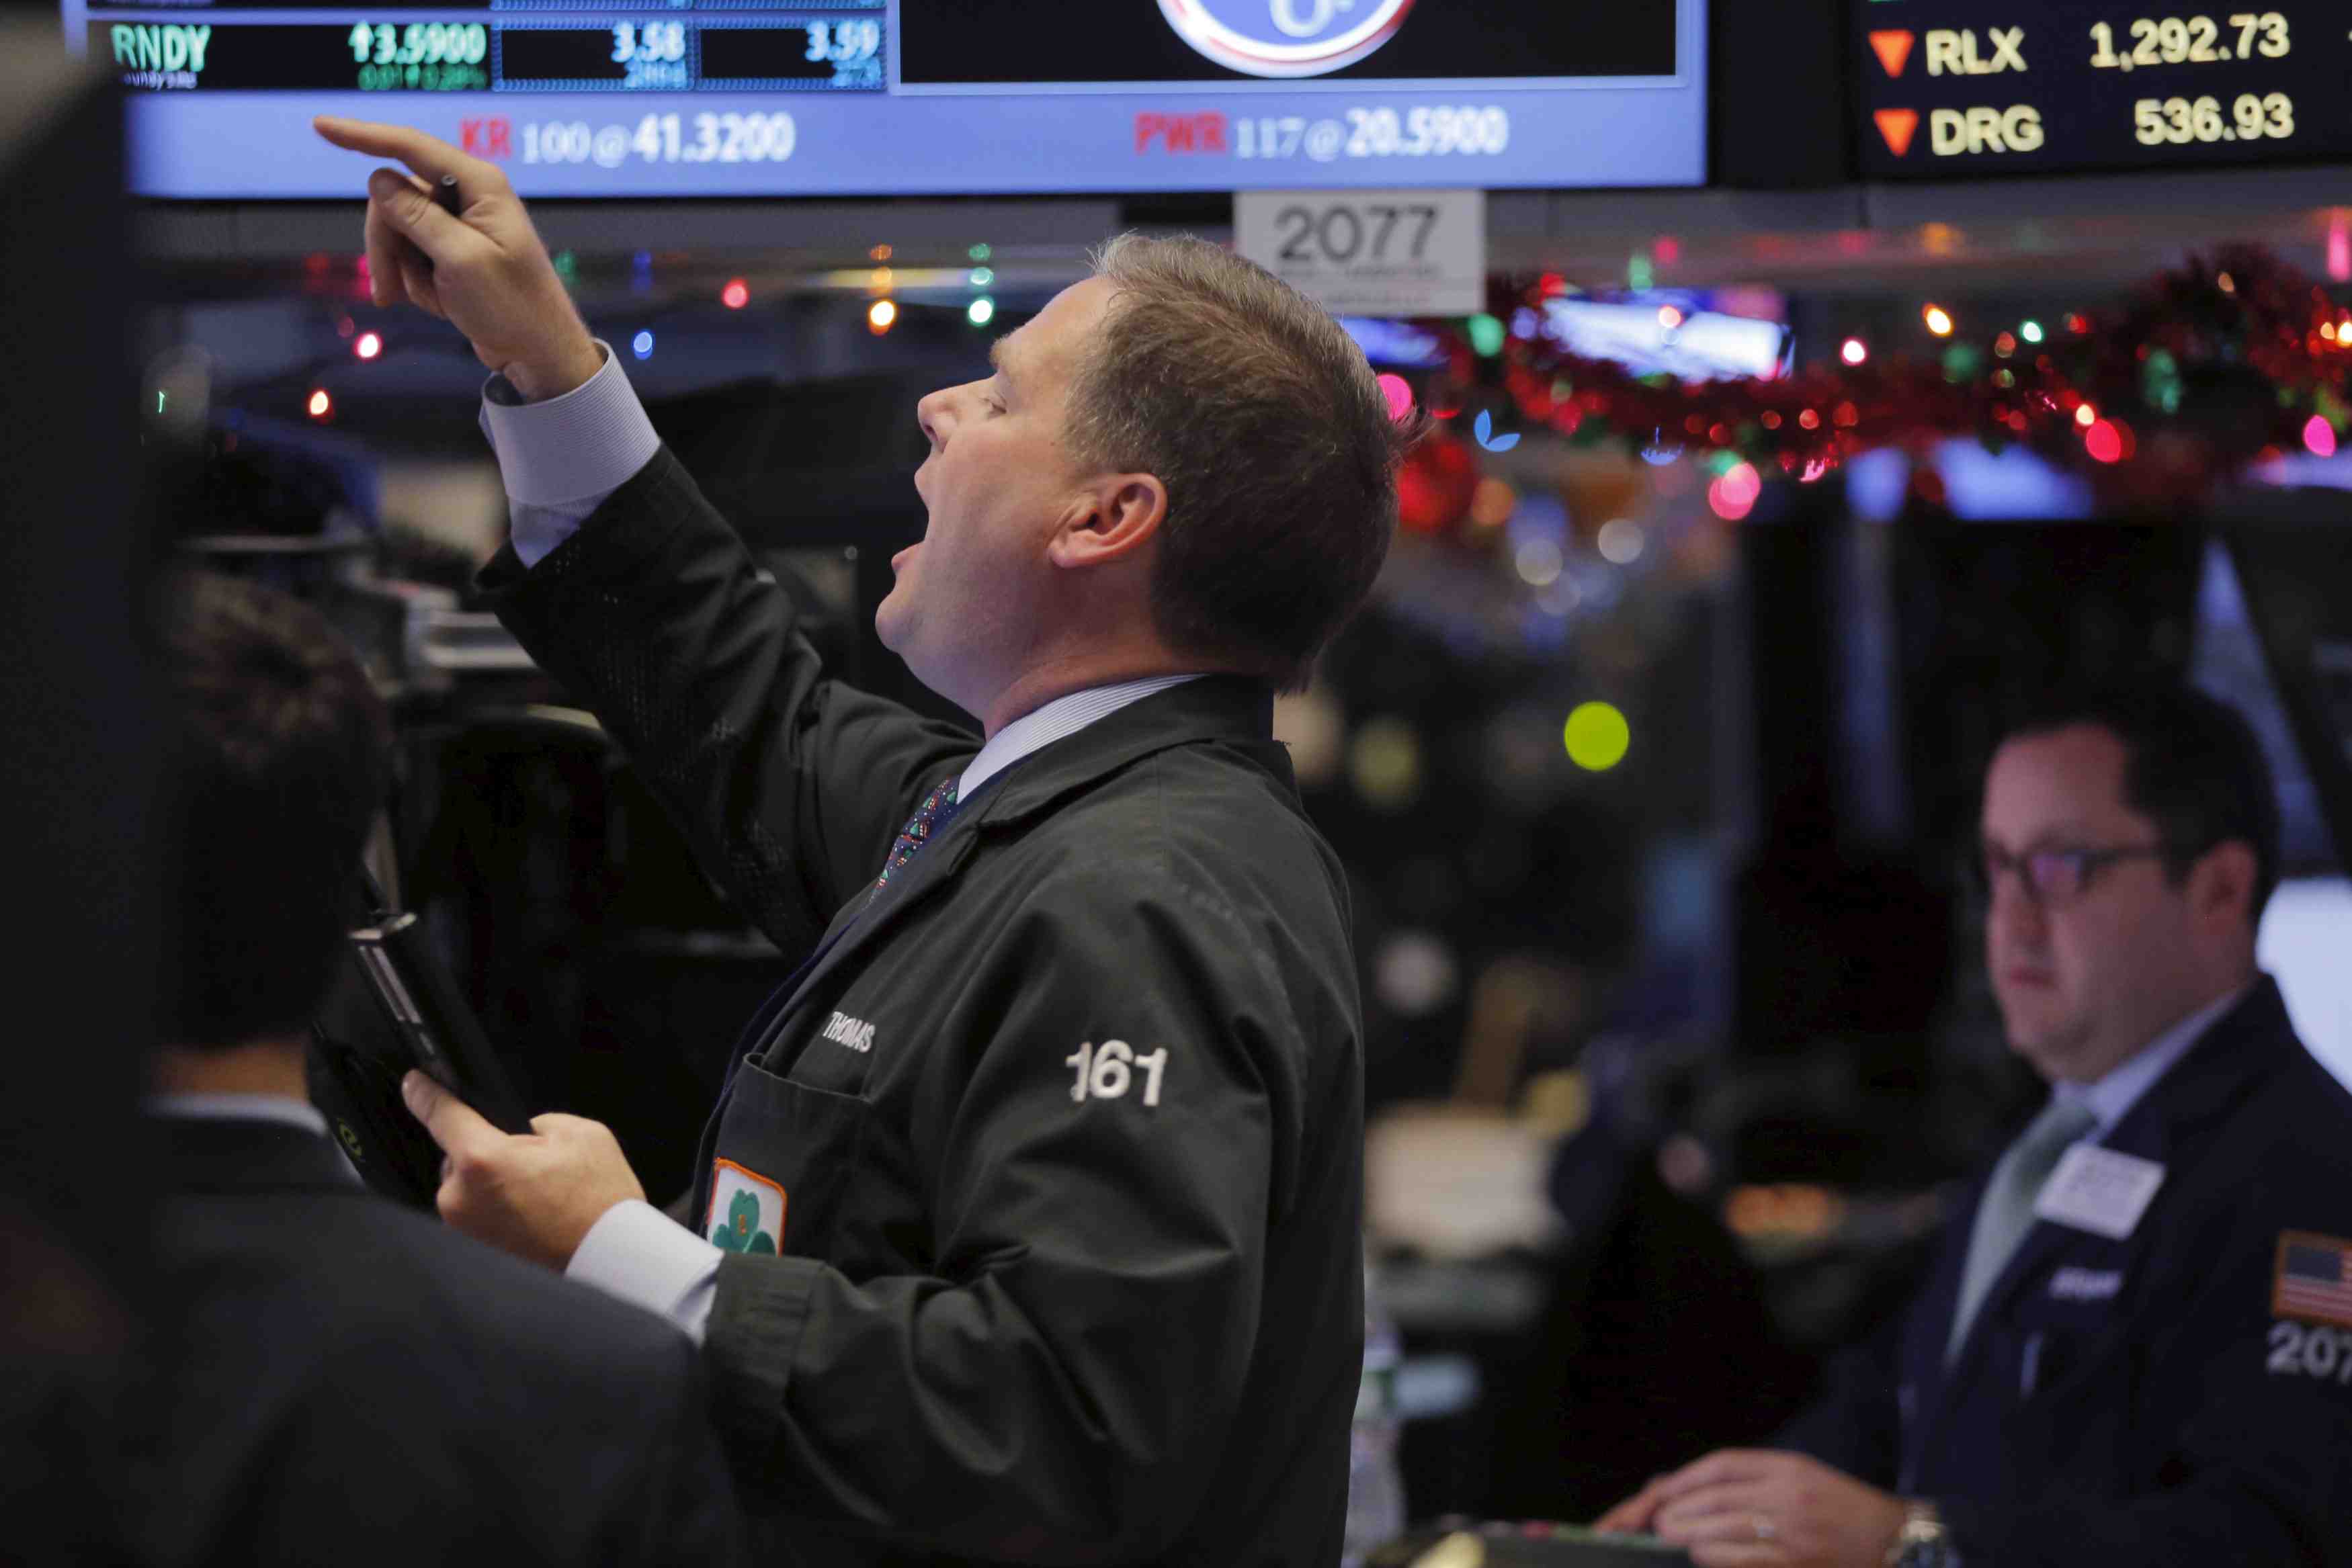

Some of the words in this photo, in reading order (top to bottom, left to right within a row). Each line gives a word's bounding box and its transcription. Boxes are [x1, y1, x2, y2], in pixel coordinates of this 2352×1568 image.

[111, 24, 210, 73] RNDY
[373, 21, 487, 65] 3.5900
[1926, 26, 2027, 77] RLX
[2089, 11, 2291, 72] 1,292.73
[460, 117, 511, 160] KR
[1134, 110, 1228, 154] PWR
[1929, 103, 2045, 157] DRG
[2134, 91, 2295, 146] 536.93
[1275, 206, 1442, 263] 2077
[822, 1010, 876, 1053] THOMAS
[1066, 1039, 1168, 1106] 161
